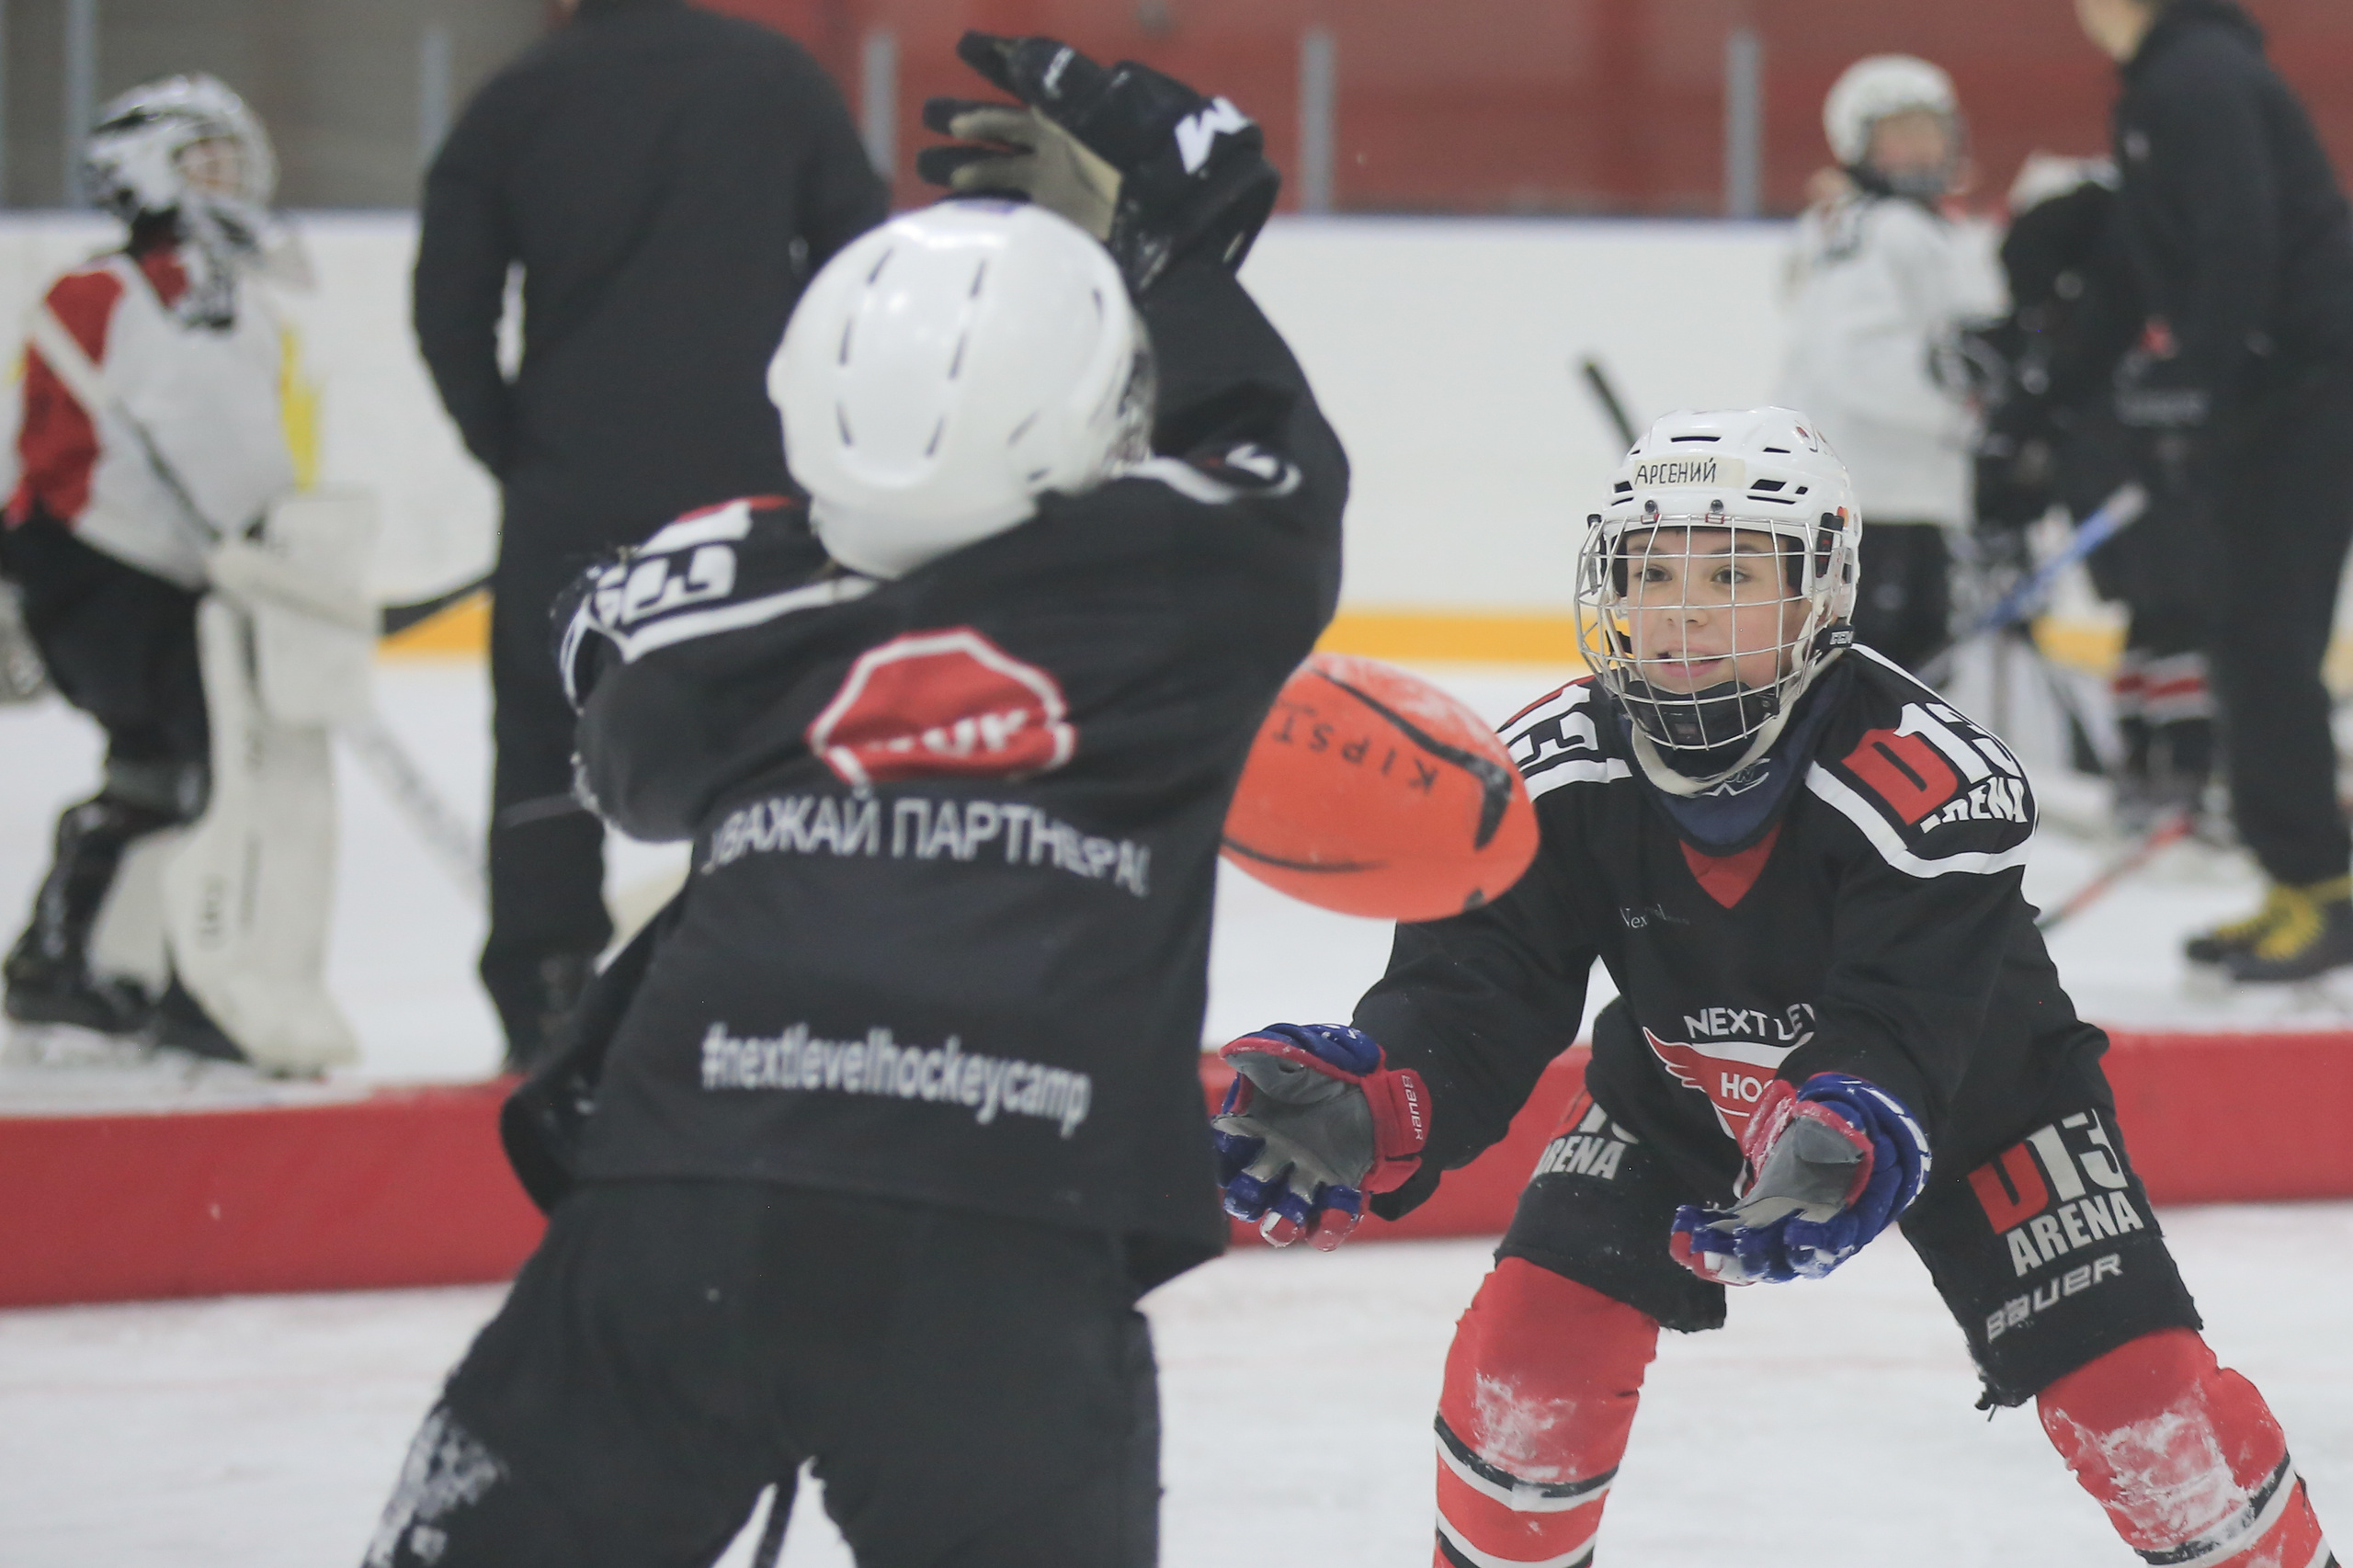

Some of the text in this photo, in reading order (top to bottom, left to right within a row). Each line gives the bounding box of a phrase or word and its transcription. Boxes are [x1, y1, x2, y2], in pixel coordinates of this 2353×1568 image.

[1634, 458, 1717, 485] АРСЕНИЙ
[1684, 1004, 1815, 1040] NEXT LE
[702, 1022, 1091, 1139] #nextlevelhockeycamp
[1721, 1073, 1773, 1103] HO
[2006, 1191, 2143, 1277] ARENA
[1986, 1253, 2123, 1344] BAUER
